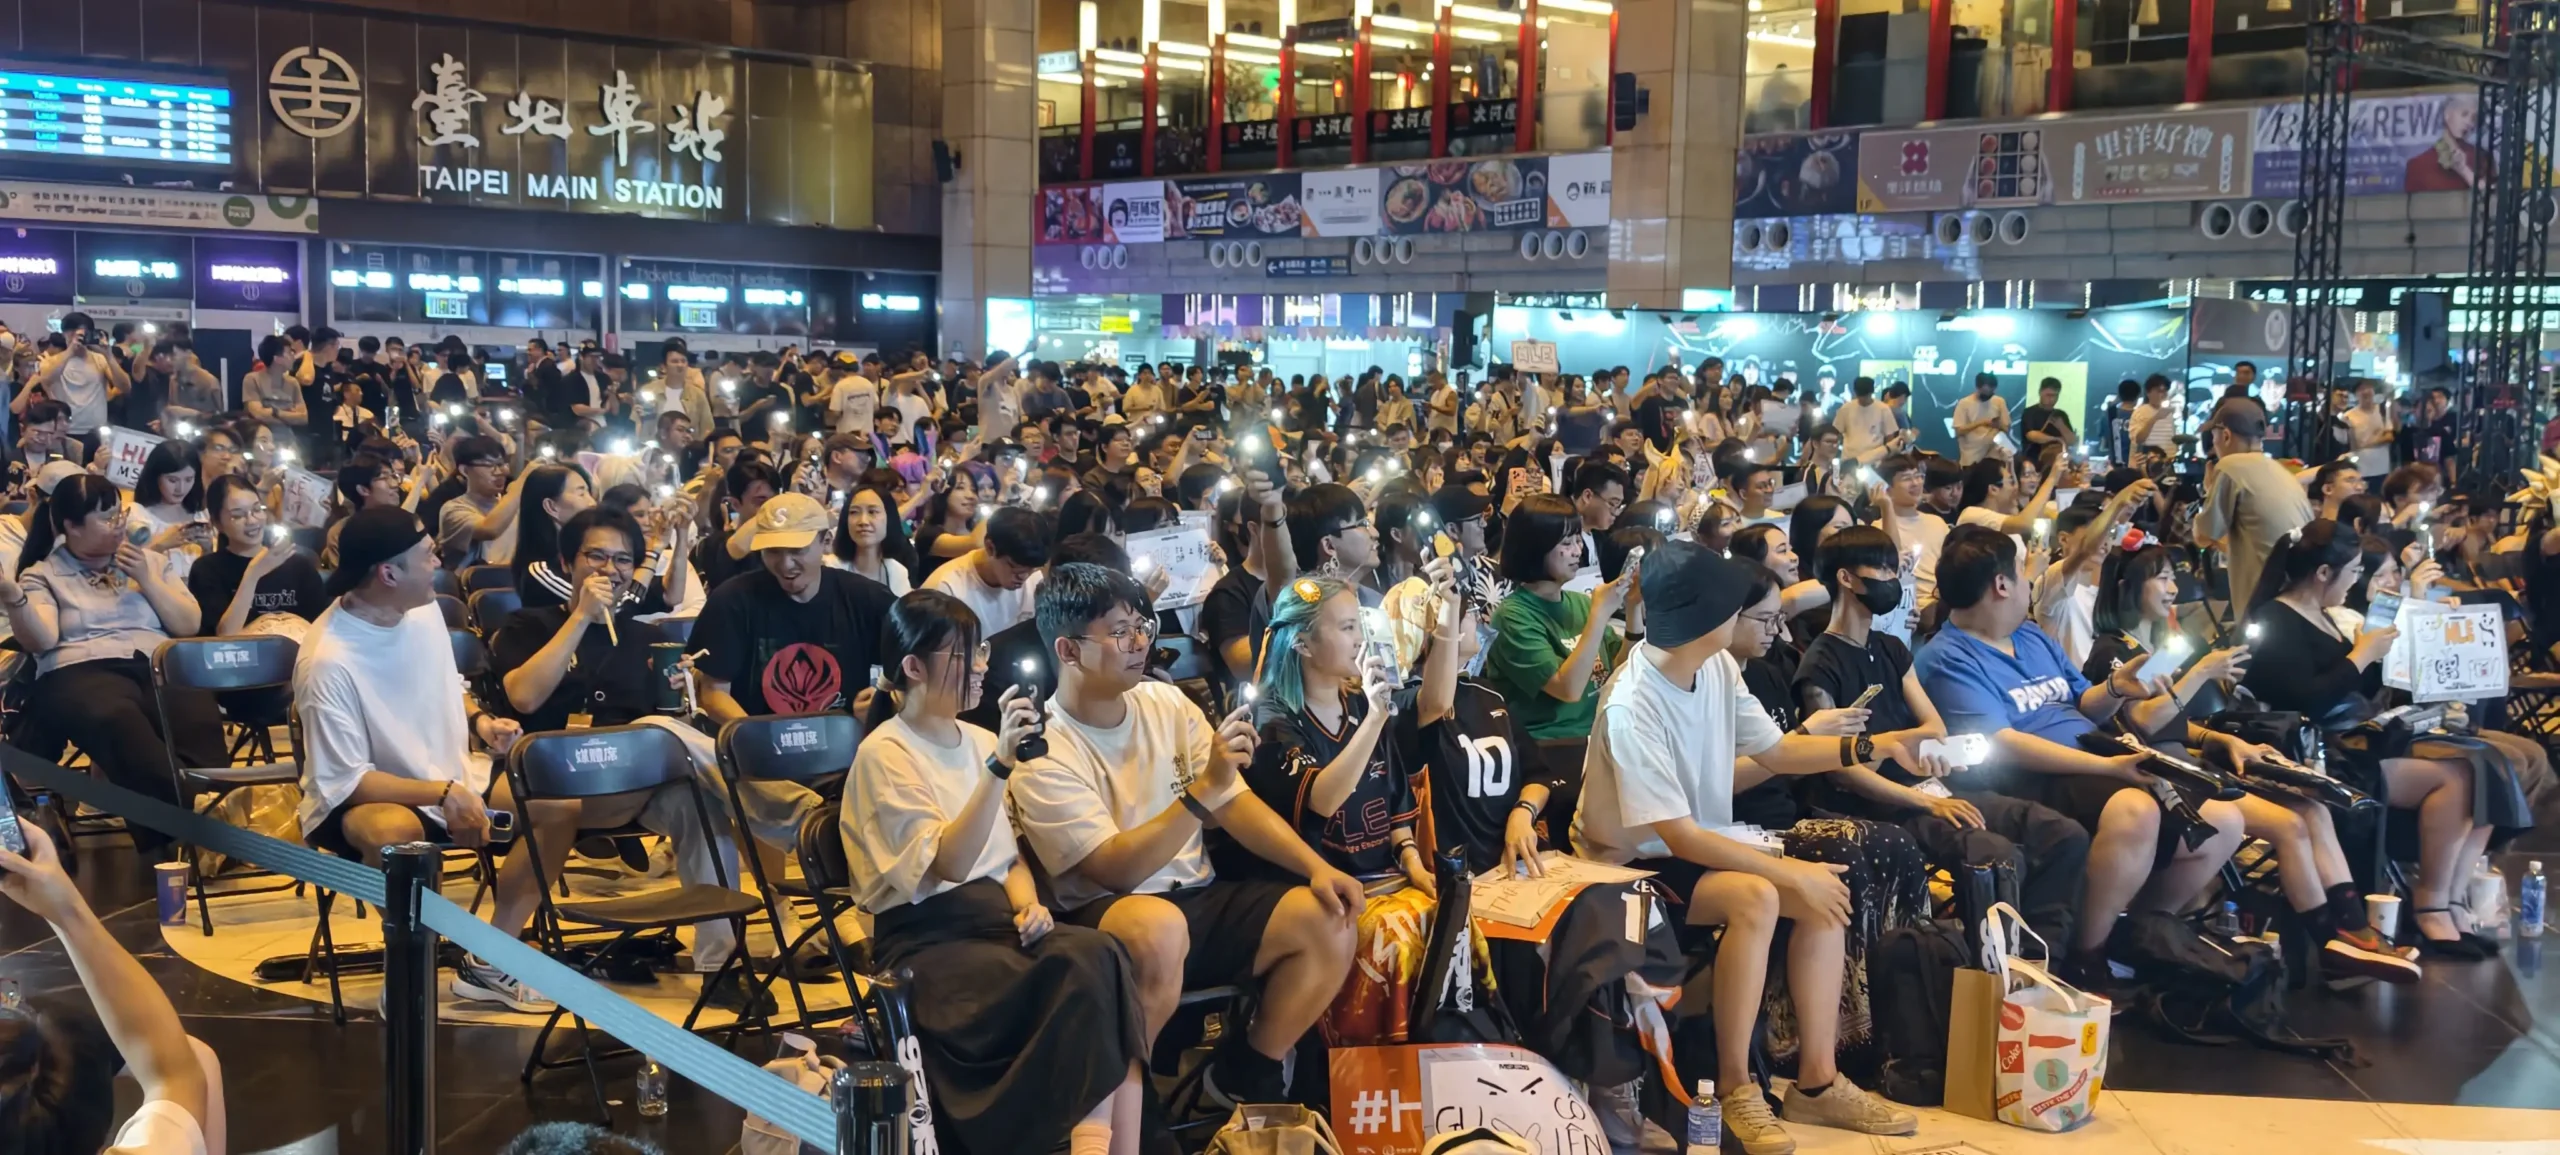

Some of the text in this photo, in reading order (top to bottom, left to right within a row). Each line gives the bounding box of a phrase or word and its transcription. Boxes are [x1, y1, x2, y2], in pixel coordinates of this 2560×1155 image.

[412, 53, 724, 167] 臺北車站
[419, 165, 723, 209] TAIPEI MAIN STATION
[1457, 733, 1512, 798] 10
[2001, 1043, 2022, 1071] Coke
